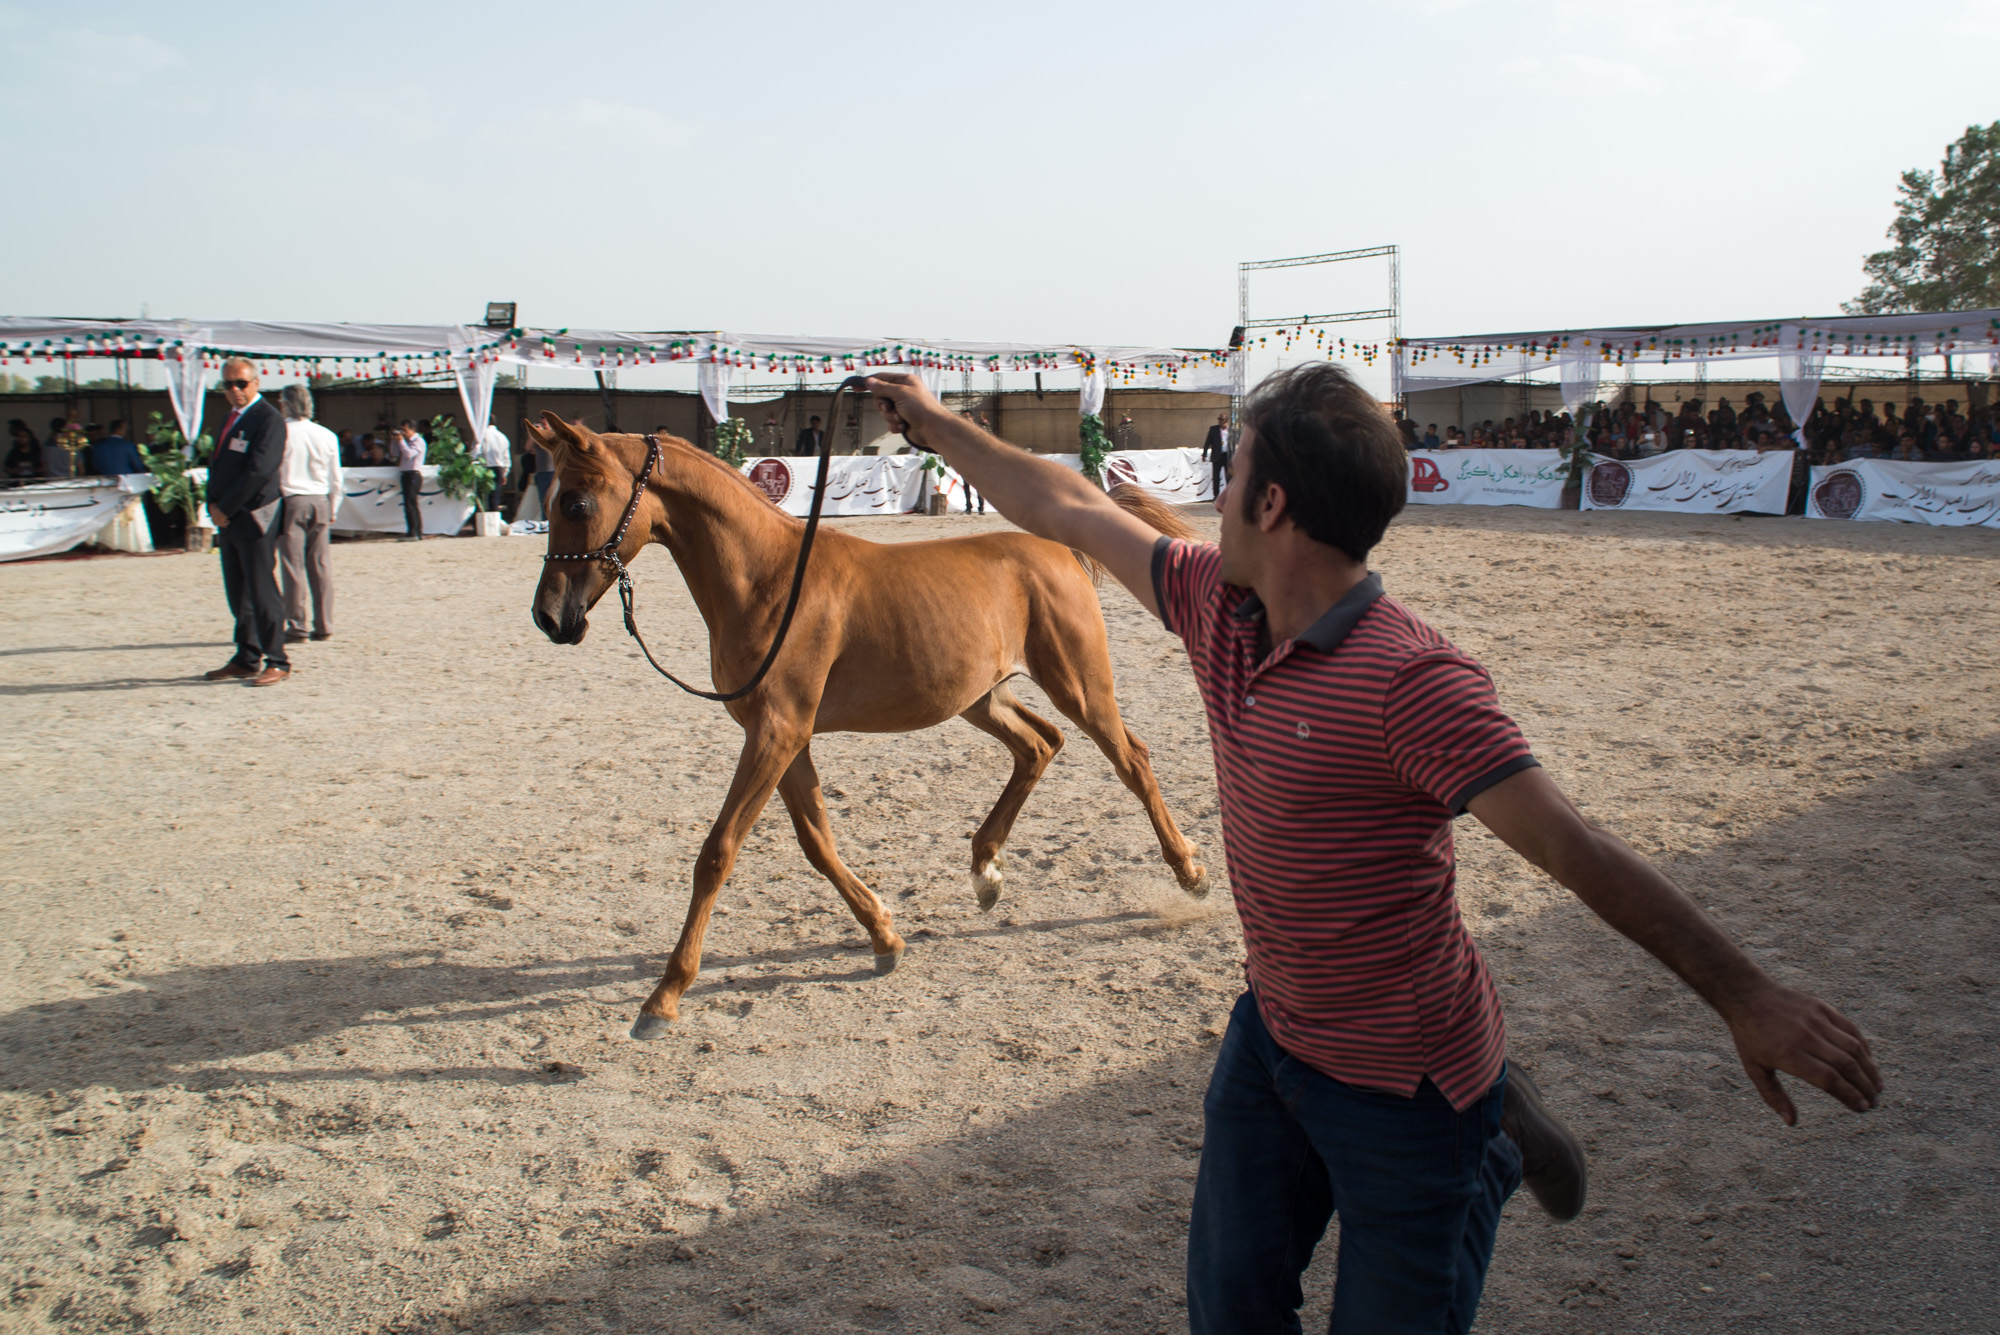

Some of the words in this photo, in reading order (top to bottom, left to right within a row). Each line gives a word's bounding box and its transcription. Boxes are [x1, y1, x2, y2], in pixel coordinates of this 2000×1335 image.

[1648, 469, 1697, 492] ایران
[1674, 478, 1723, 502] اصیل
[1882, 481, 1937, 505] ایران
[1913, 493, 1970, 516] اصیل
